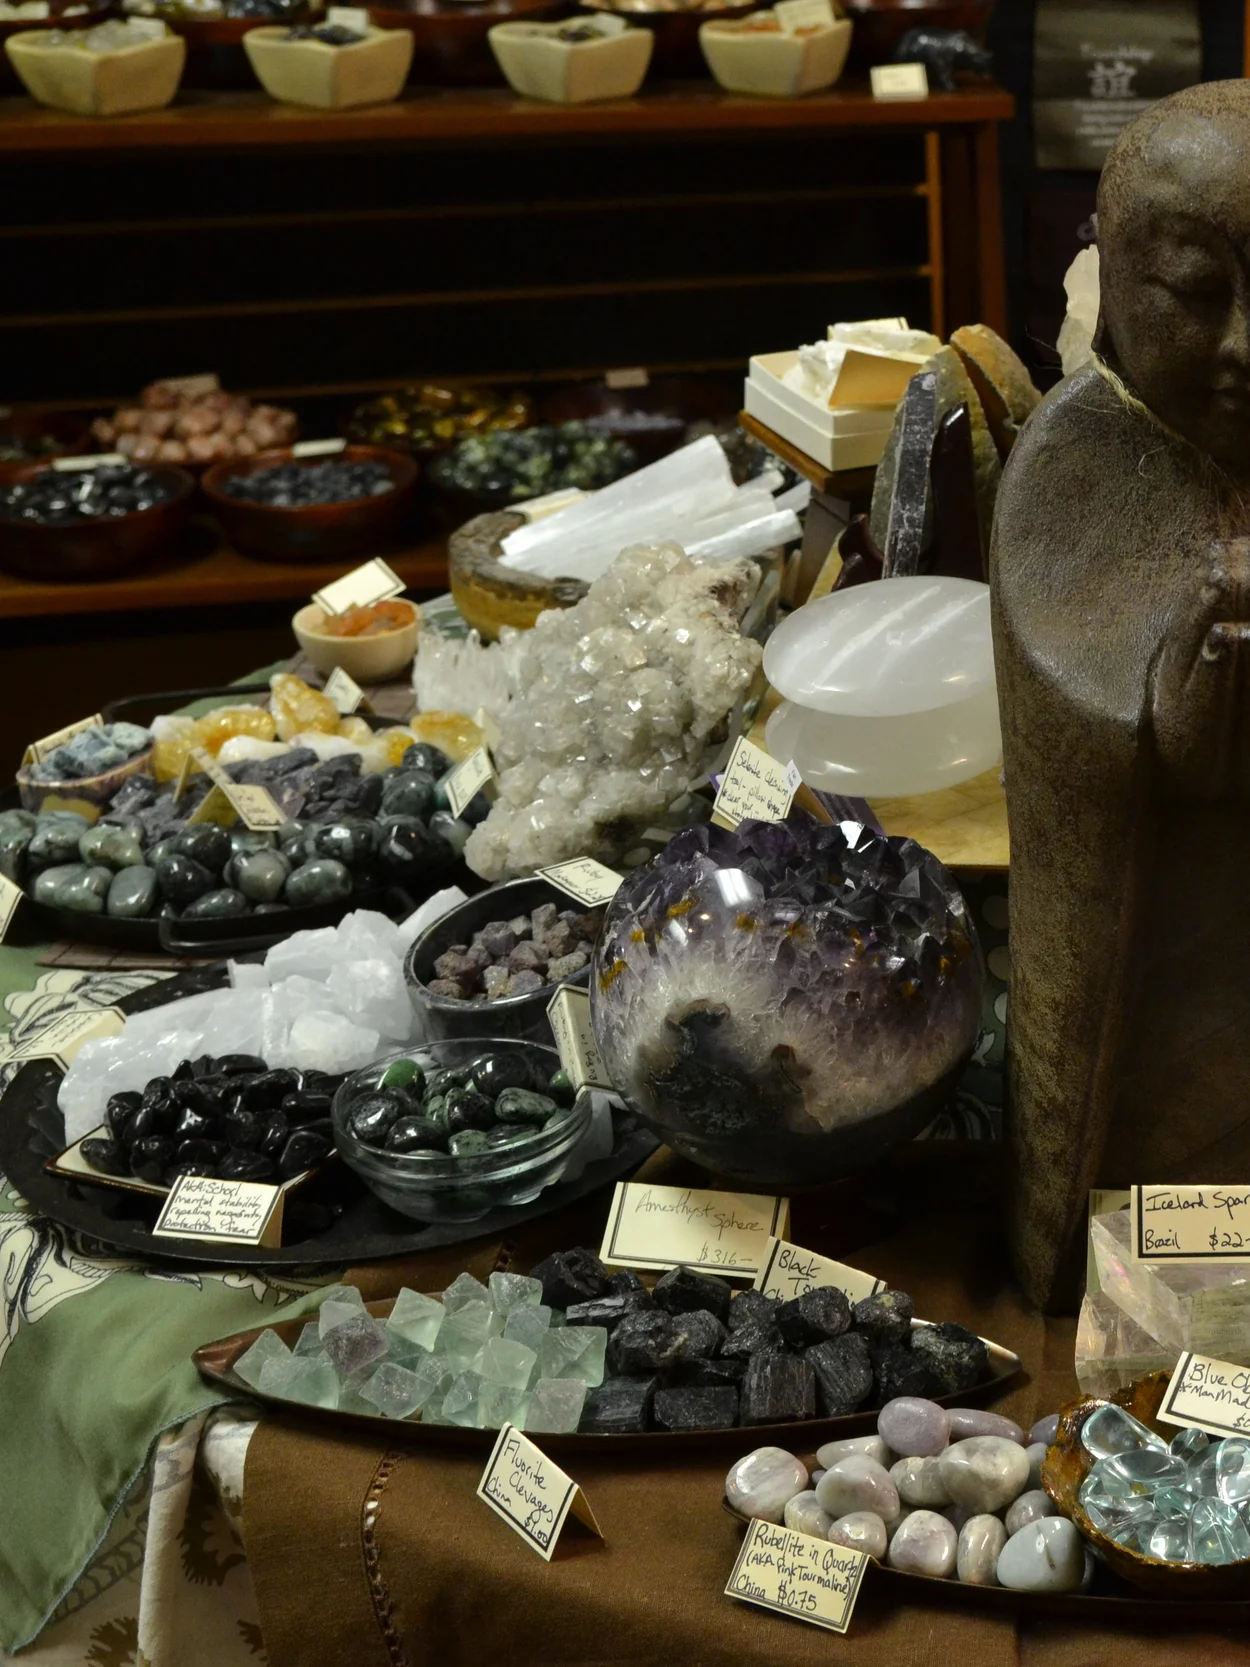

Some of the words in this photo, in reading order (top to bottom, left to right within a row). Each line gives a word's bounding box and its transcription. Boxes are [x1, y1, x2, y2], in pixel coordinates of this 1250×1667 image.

[709, 1212, 765, 1241] Sphere
[1144, 1228, 1181, 1251] Brazil
[778, 1249, 822, 1279] Black
[1189, 1363, 1227, 1386] Blue
[503, 1438, 547, 1490] Fluorite
[754, 1523, 805, 1557] Rubellite
[809, 1545, 819, 1566] in
[822, 1548, 858, 1578] Quartz
[735, 1574, 767, 1600] China
[777, 1580, 818, 1612] $0.75
